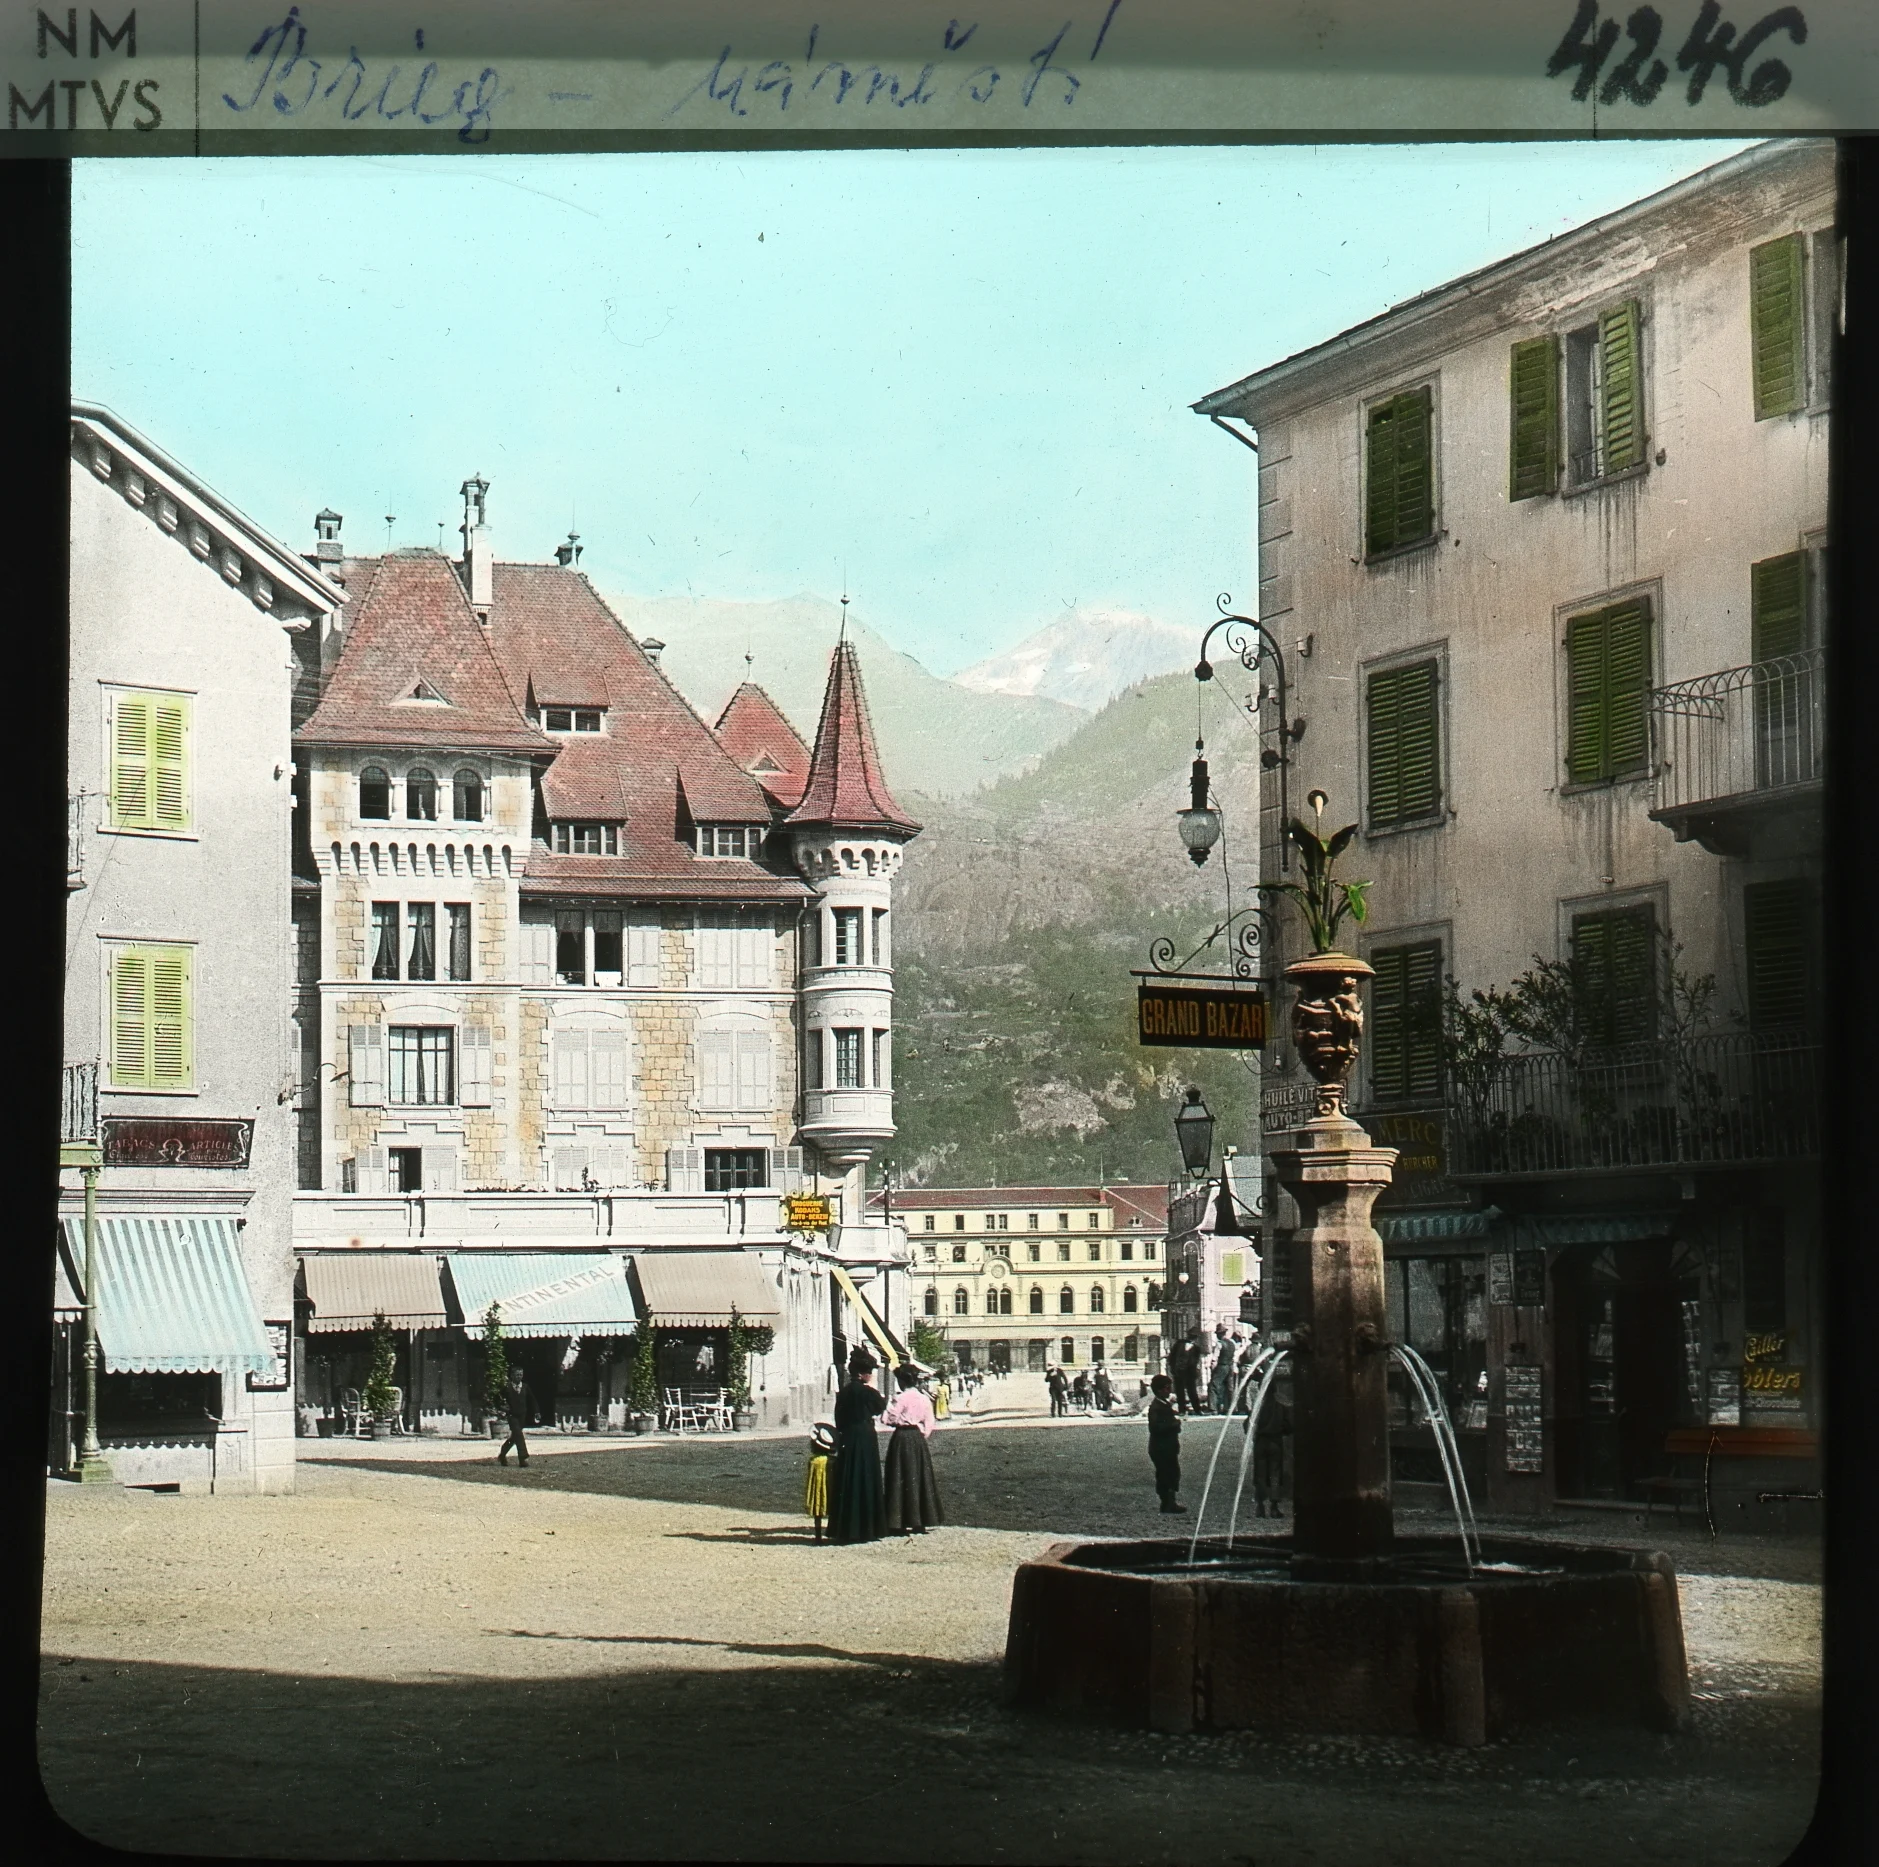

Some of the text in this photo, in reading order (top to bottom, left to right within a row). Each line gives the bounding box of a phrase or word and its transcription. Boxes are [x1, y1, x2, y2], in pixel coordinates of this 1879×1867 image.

[37, 8, 137, 59] NM
[1545, 0, 1808, 107] 4246
[8, 79, 163, 131] MTVS
[1142, 998, 1262, 1039] GRAND BAZAR
[1264, 1086, 1318, 1108] HUILE VIT
[187, 1140, 239, 1153] ARTICLES
